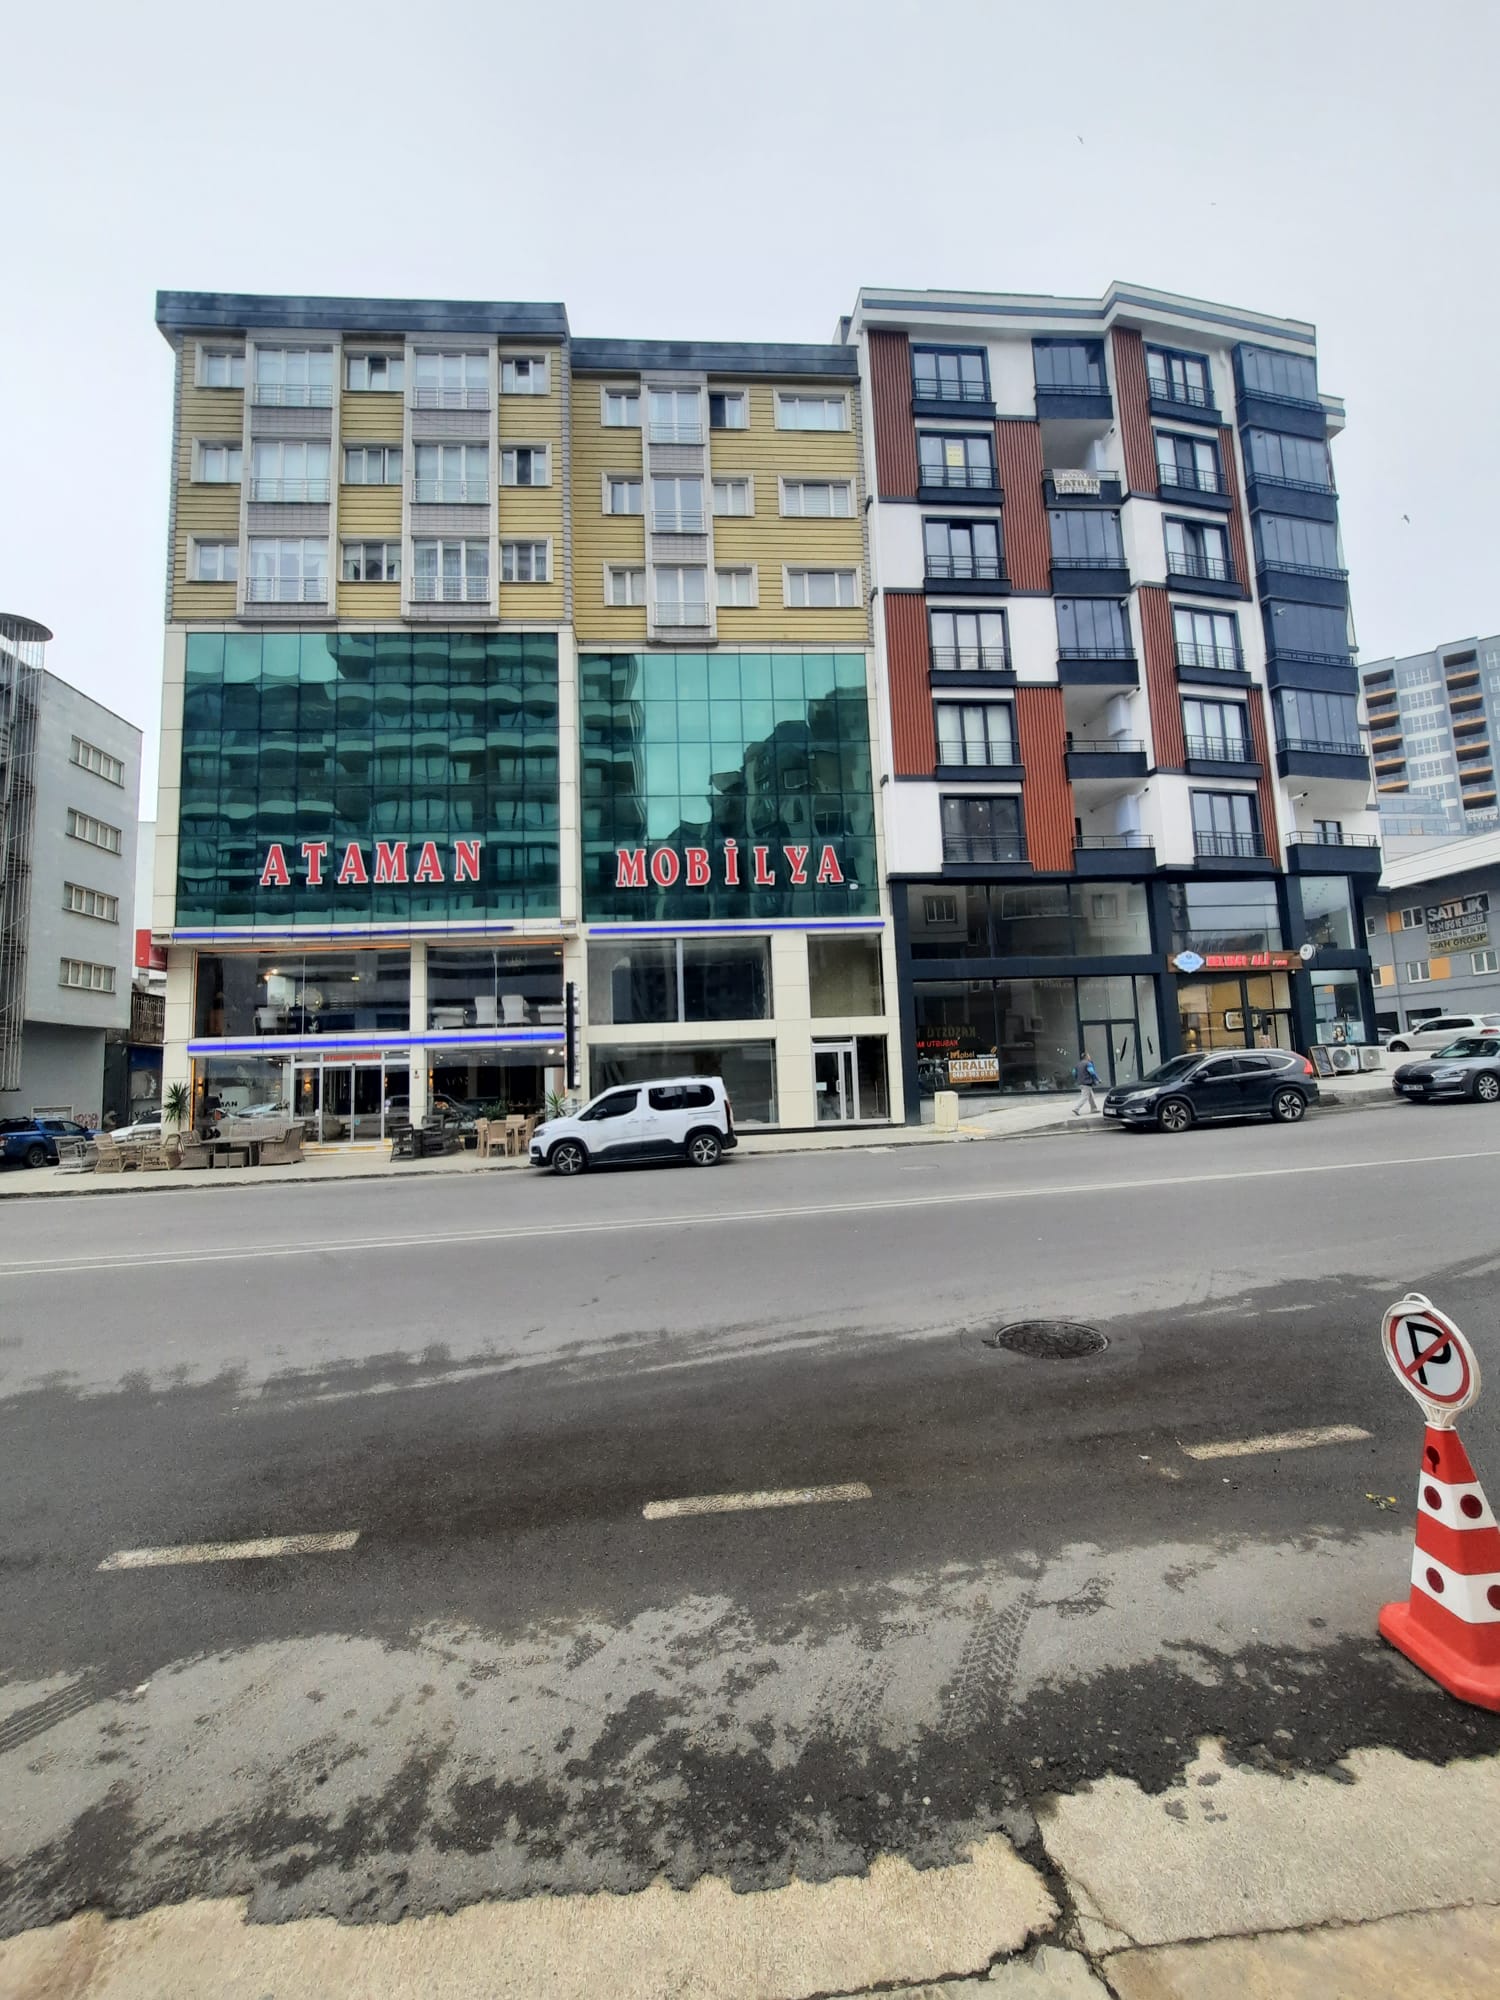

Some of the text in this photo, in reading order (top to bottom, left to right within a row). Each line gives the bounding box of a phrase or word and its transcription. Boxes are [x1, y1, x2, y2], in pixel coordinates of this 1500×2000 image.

[1055, 479, 1098, 488] SATILIK
[260, 838, 844, 887] ATAMAN MOBİLYA
[1427, 897, 1483, 922] SATILIK
[1453, 933, 1487, 945] GROUP
[1405, 1321, 1451, 1385] P
